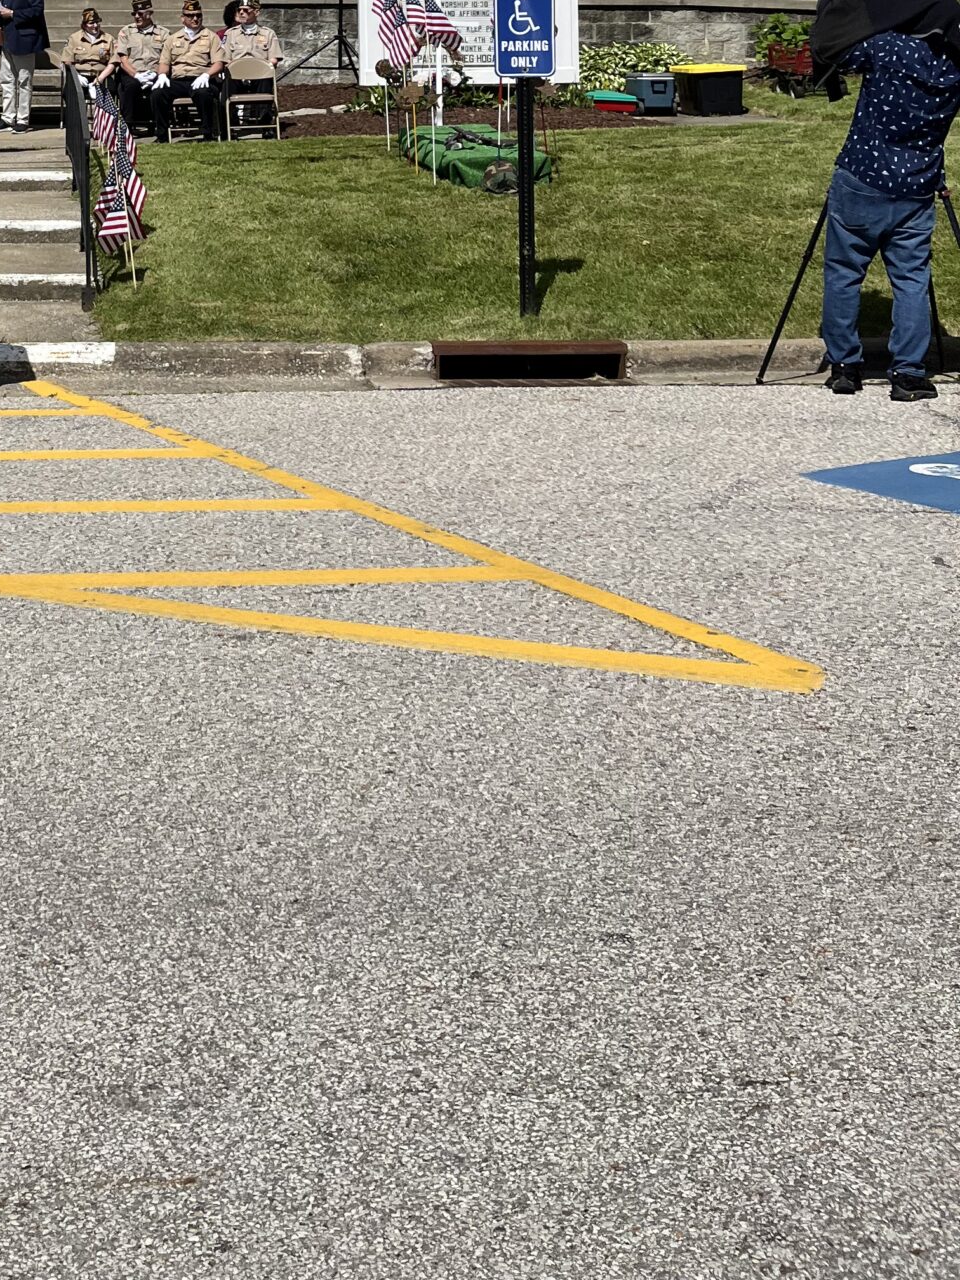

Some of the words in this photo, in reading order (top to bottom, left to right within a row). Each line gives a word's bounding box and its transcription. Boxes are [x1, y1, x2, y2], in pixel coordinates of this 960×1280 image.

[501, 40, 549, 52] PARKING
[417, 55, 447, 64] PASTR
[511, 56, 538, 68] ONLY
